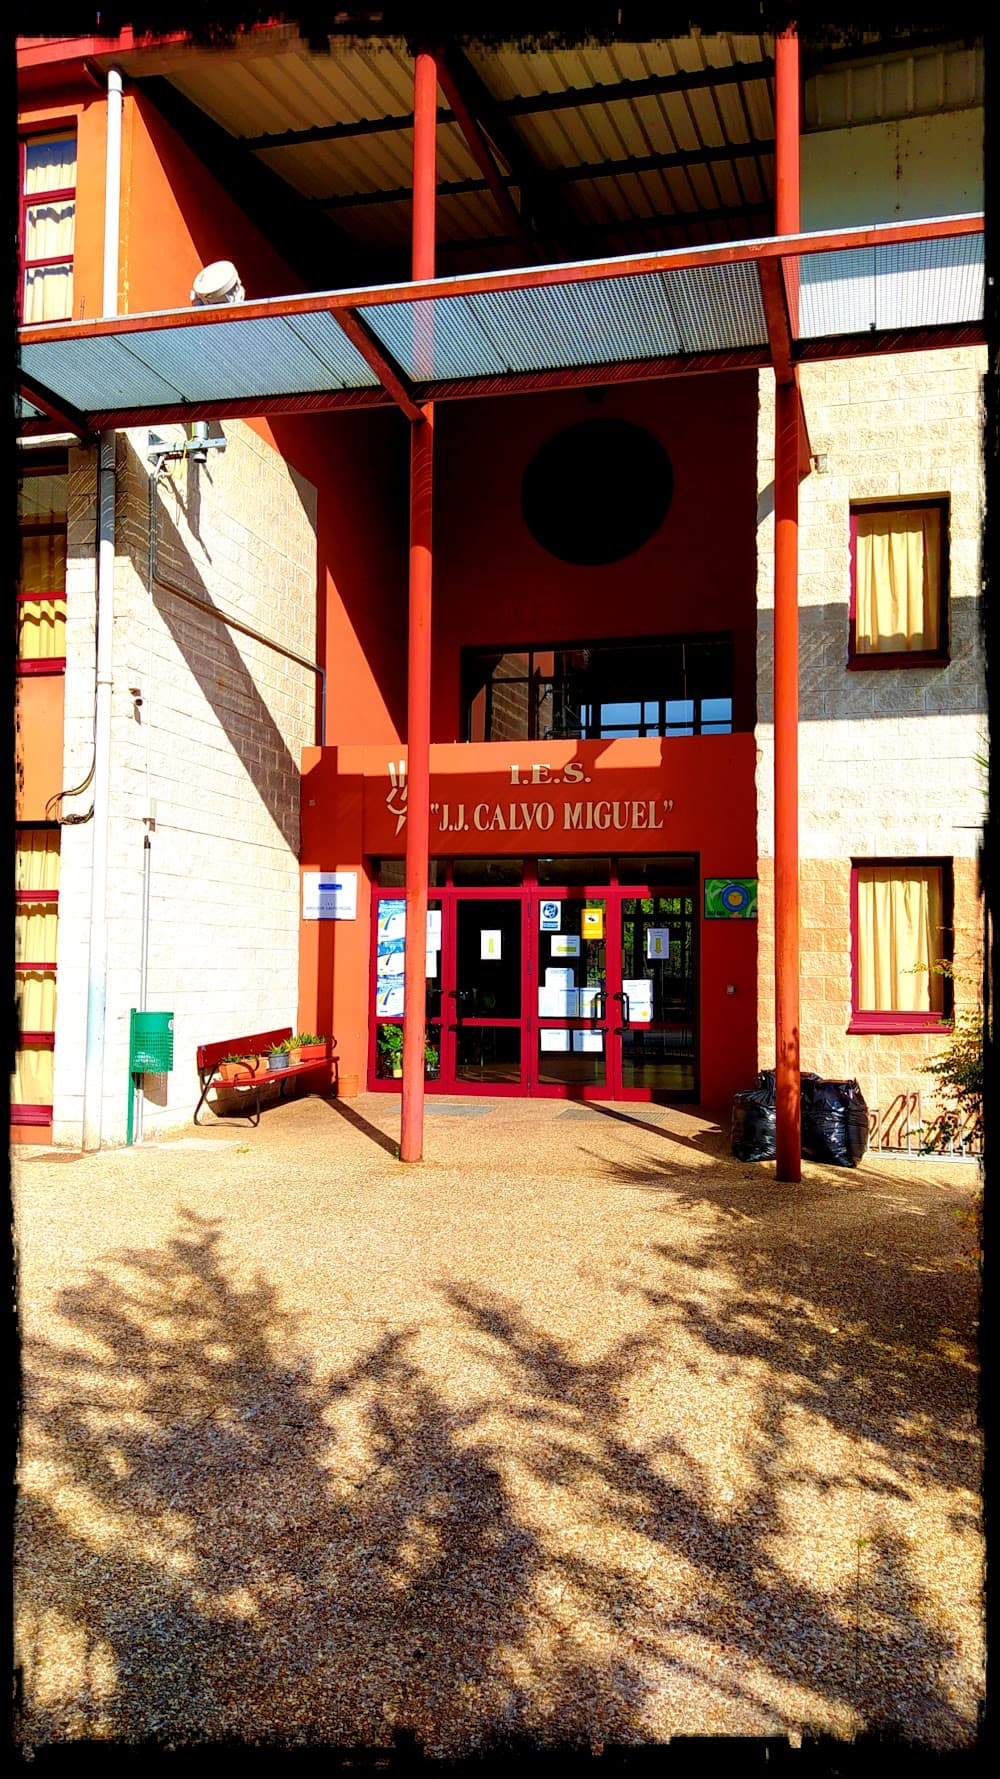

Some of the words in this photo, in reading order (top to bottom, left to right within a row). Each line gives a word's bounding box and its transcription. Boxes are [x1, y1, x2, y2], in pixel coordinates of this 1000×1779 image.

[509, 762, 592, 785] I.E.S.
[473, 802, 555, 831] CALVO
[563, 800, 674, 831] MIGUEL"
